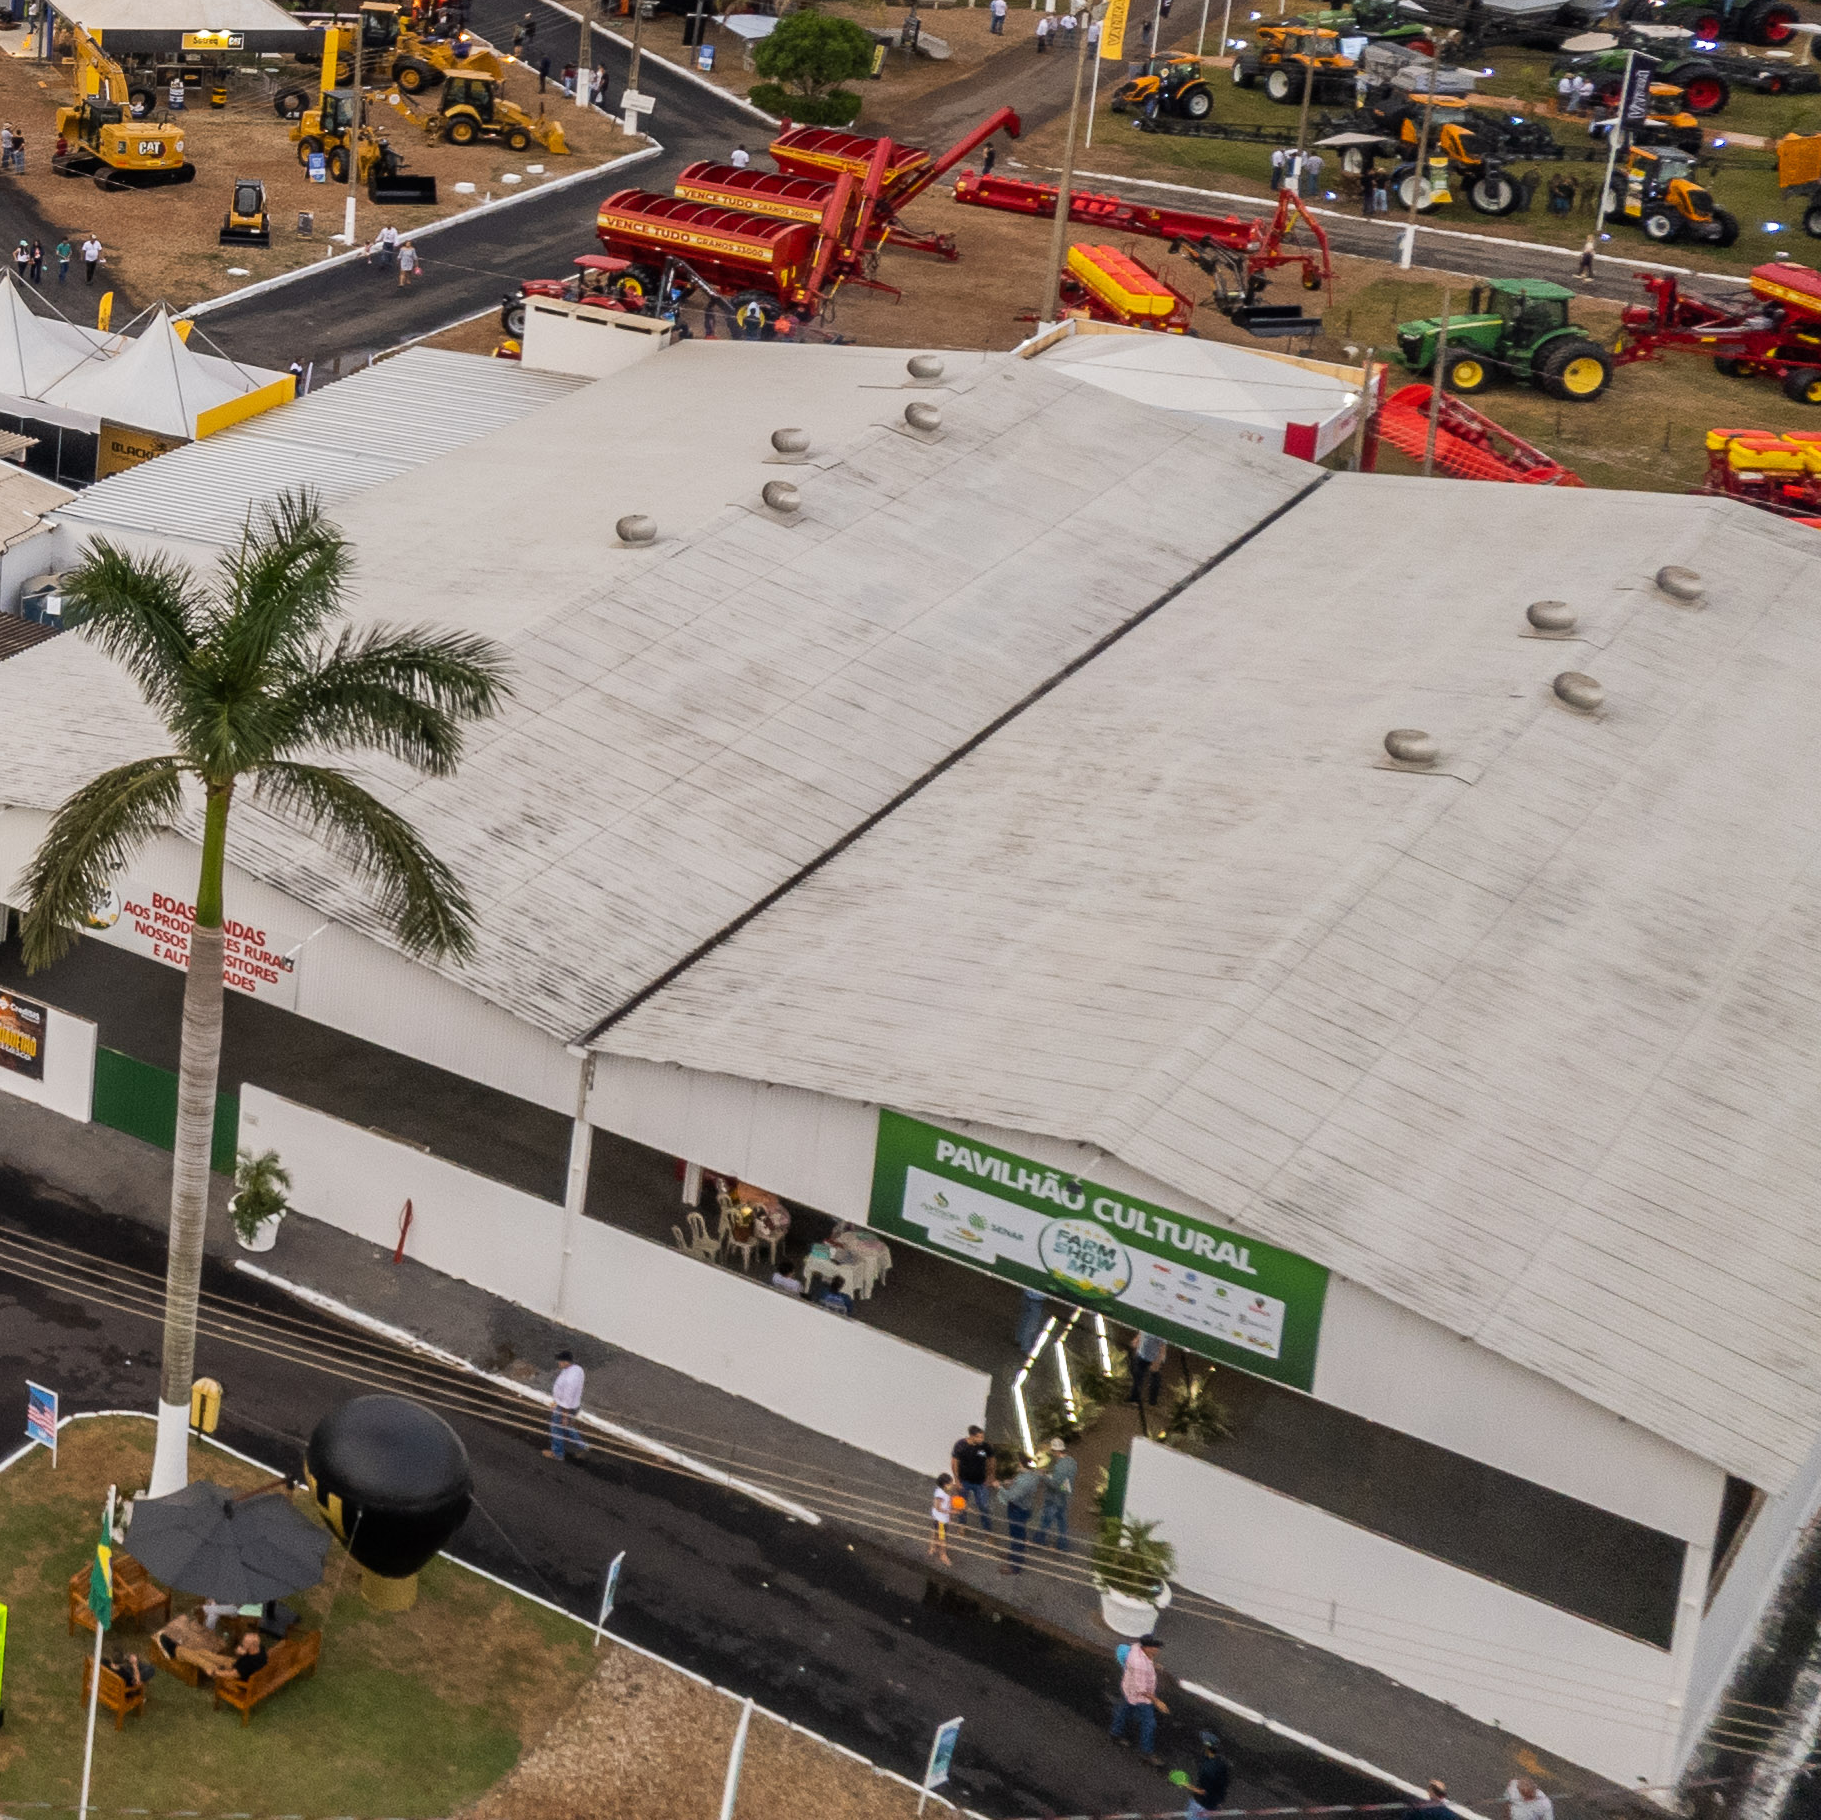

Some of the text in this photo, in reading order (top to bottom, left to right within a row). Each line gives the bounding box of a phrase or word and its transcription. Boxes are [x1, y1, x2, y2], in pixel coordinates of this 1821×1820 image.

[193, 36, 243, 46] Sotreq CAT
[1629, 70, 1651, 119] VALTRA
[138, 140, 161, 155] CAT
[682, 188, 721, 204] VENCE
[723, 196, 753, 209] TUDO
[607, 217, 651, 234] VENCE
[653, 226, 691, 243] TUDO
[124, 901, 151, 920] AOS
[152, 892, 197, 922] BOAS
[135, 920, 188, 950] NOSSOS
[153, 943, 161, 957] E
[936, 1137, 1258, 1276] PAVILHÃO CULTURAL
[990, 1222, 1024, 1242] SENAR
[1053, 1240, 1116, 1273] SHOW
[1056, 1229, 1117, 1261] FARM
[1066, 1259, 1098, 1279] MT
